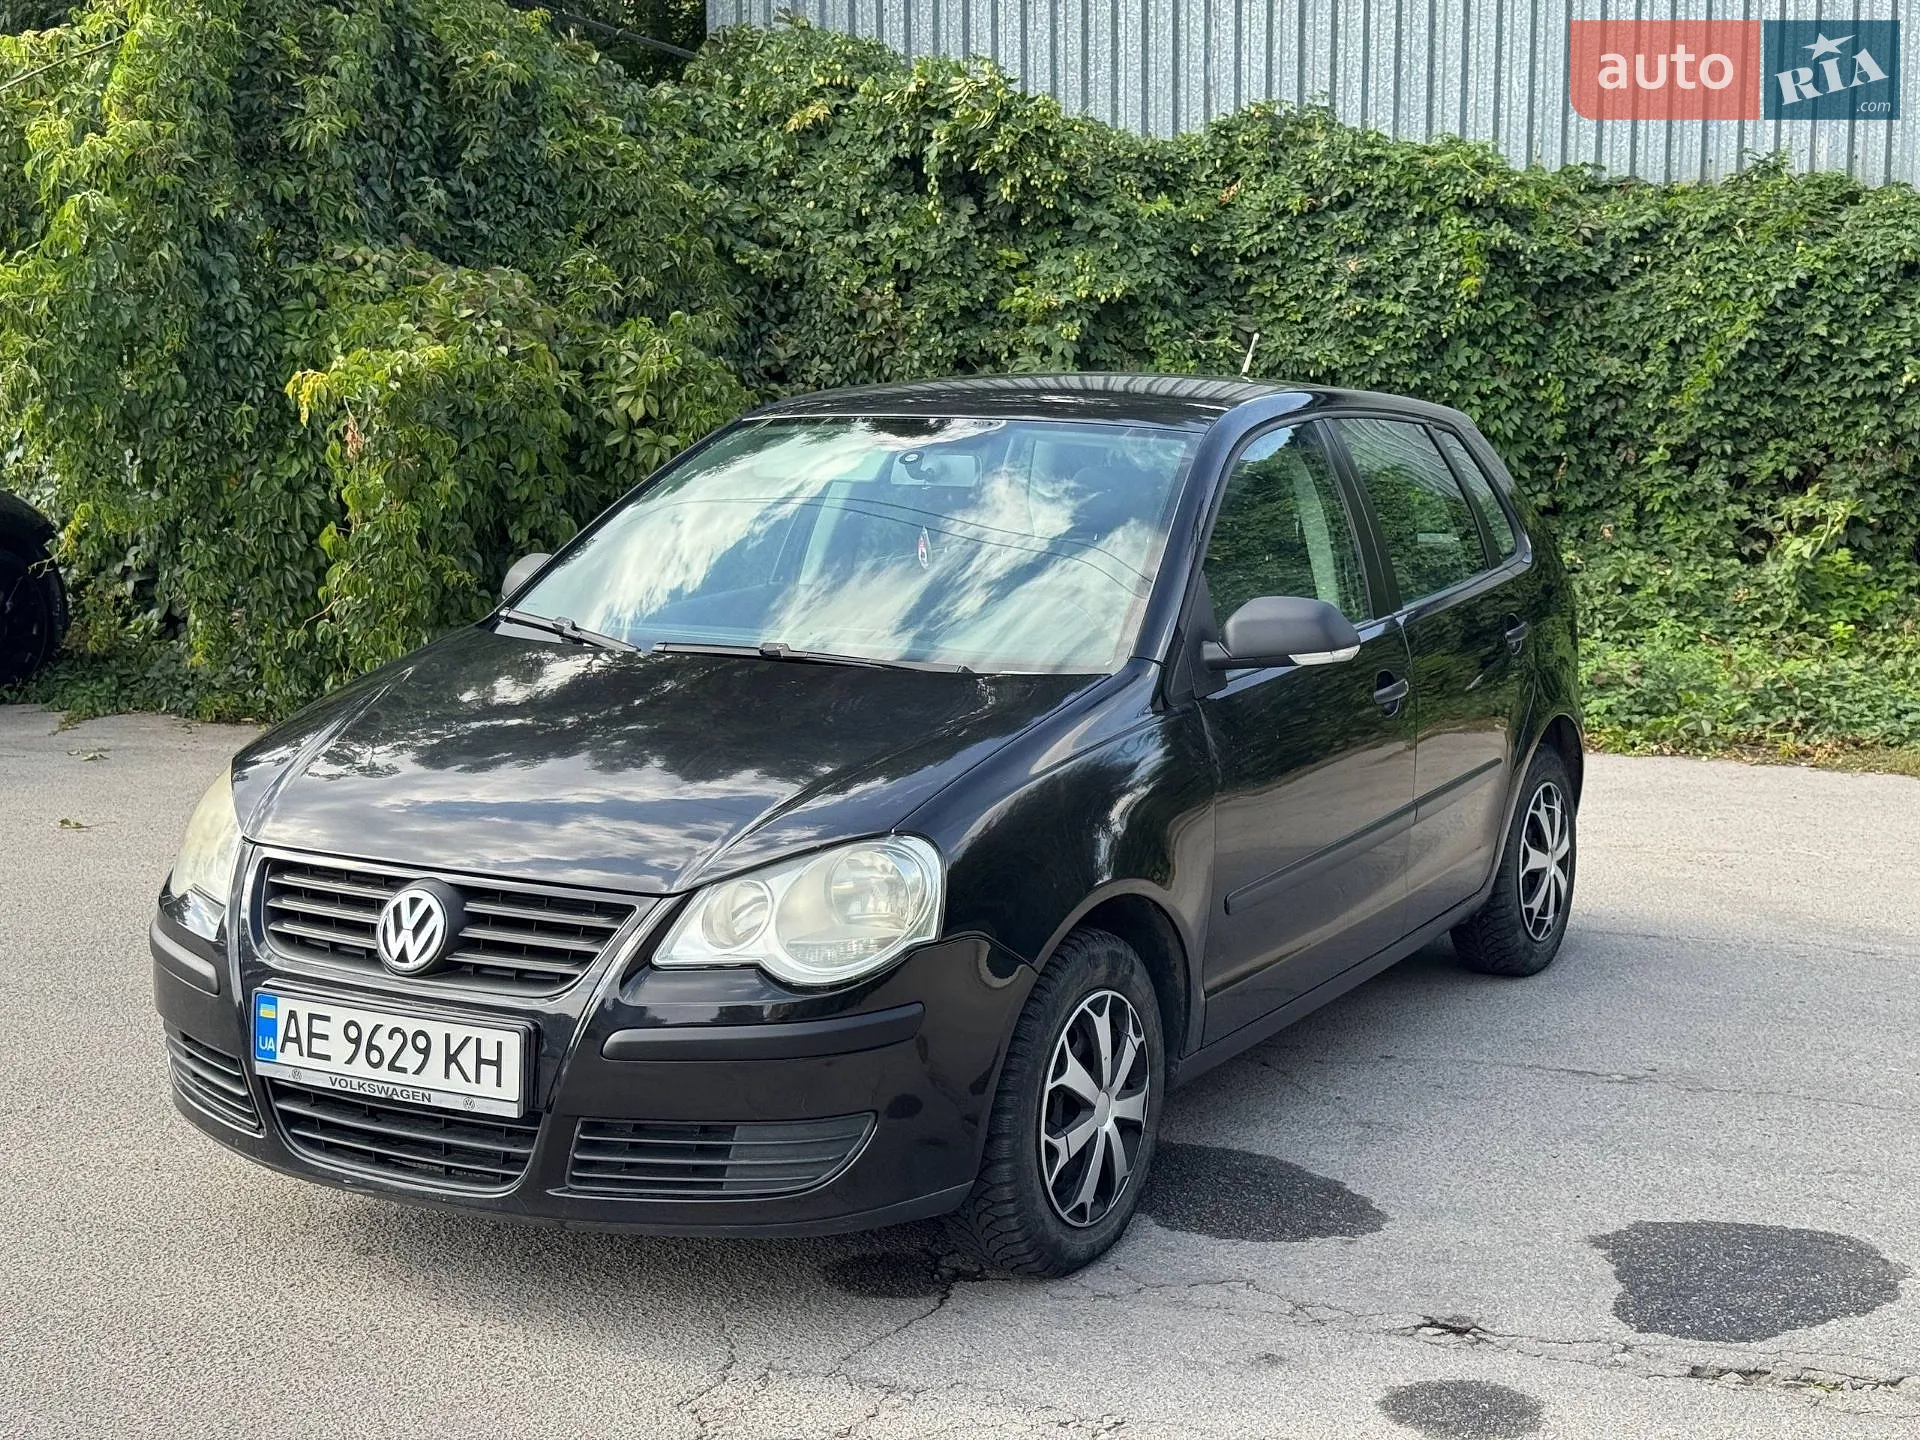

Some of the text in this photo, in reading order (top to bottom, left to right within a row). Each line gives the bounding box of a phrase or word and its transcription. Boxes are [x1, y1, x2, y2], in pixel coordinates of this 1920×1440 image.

[258, 1035, 276, 1053] UA
[279, 1009, 503, 1088] AE 9629 KH
[328, 1075, 432, 1103] VOLKSWAGEN
